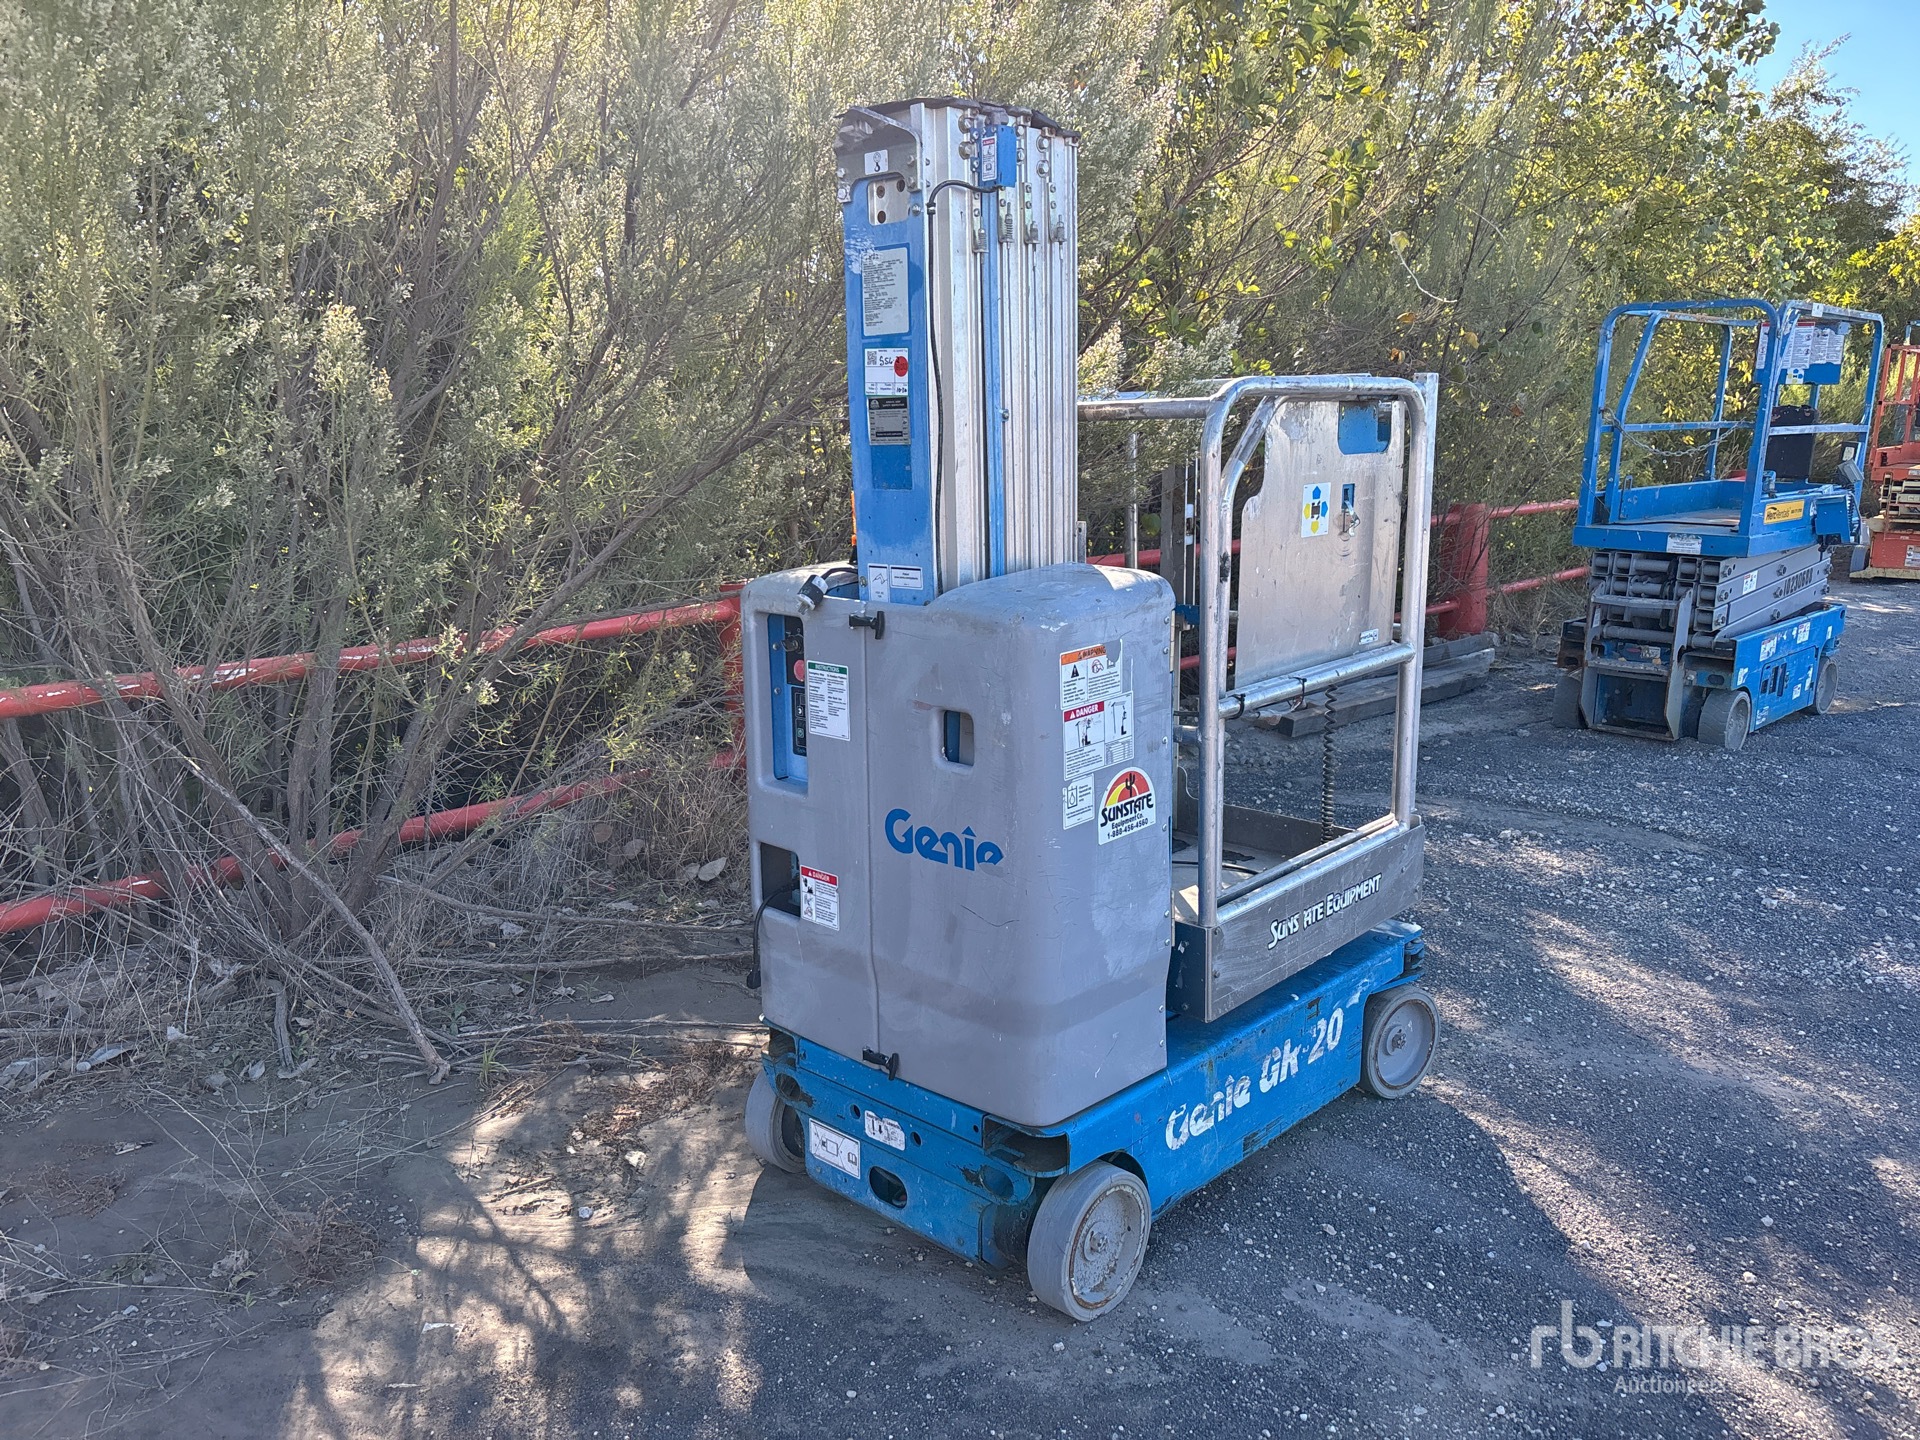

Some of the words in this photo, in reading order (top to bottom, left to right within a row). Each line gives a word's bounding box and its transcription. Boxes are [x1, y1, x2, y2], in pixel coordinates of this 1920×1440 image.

[1076, 703, 1099, 718] DANGER
[1100, 793, 1154, 827] SUNSTATE
[1111, 814, 1137, 829] Equipment
[884, 808, 1004, 871] Genie
[812, 871, 830, 882] DANGER
[1325, 872, 1382, 918] EQUIPMENT
[1165, 1074, 1251, 1150] Genie
